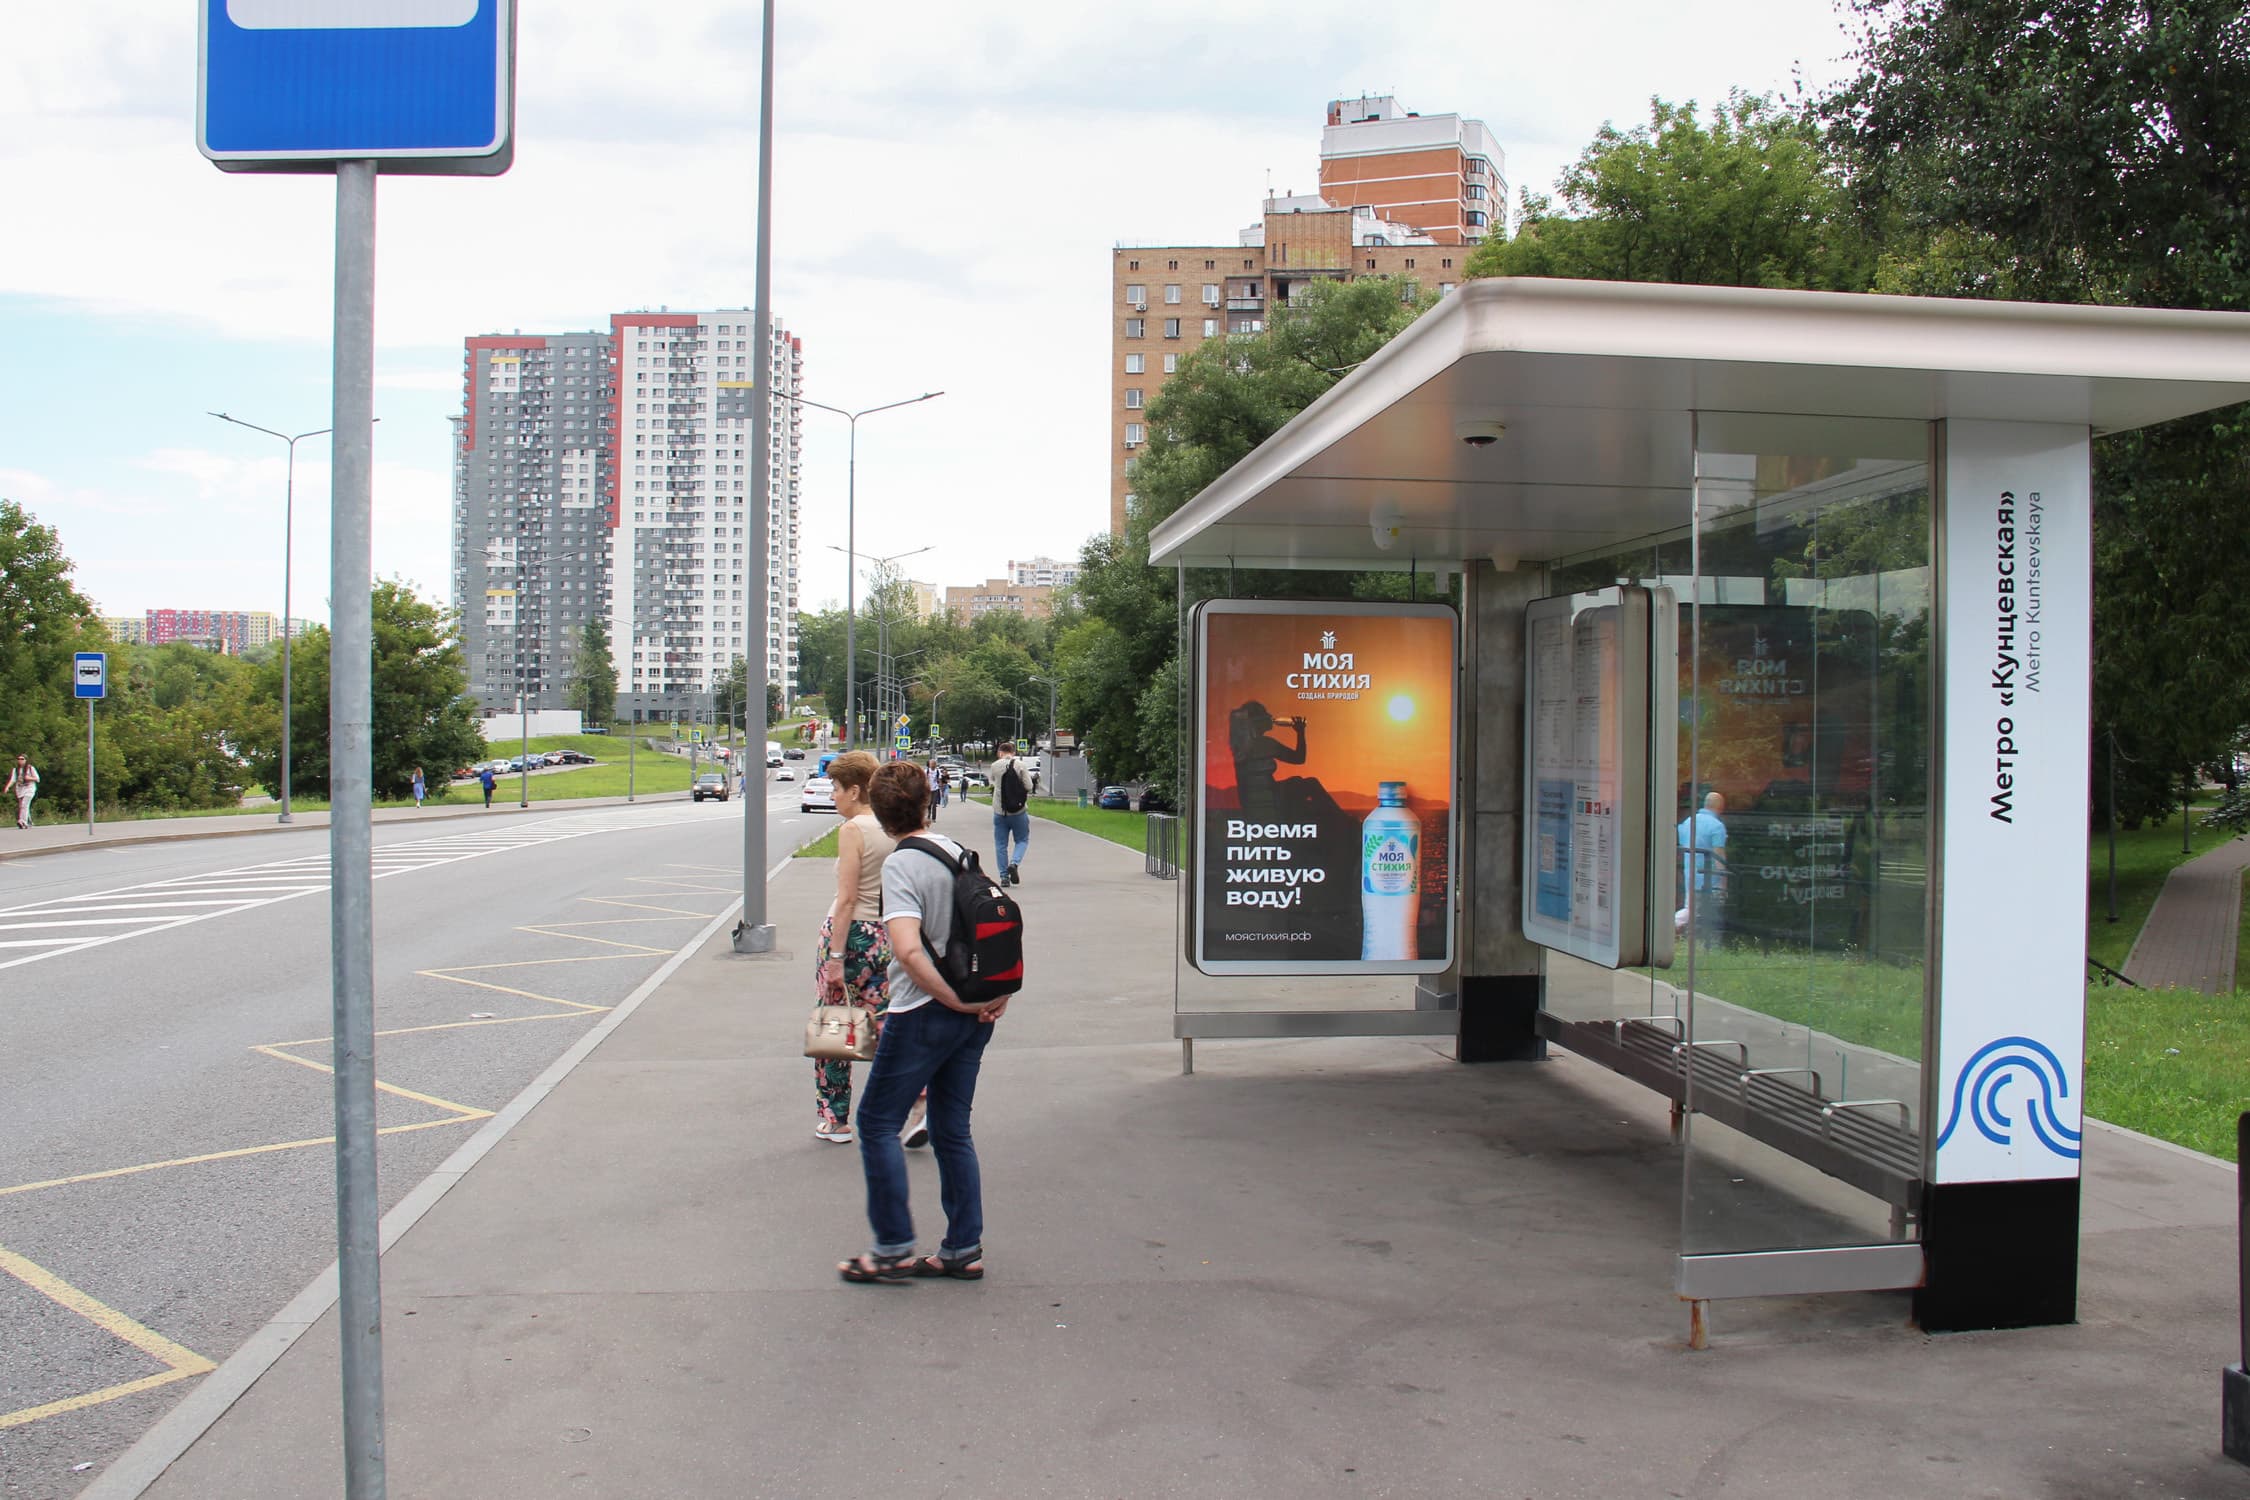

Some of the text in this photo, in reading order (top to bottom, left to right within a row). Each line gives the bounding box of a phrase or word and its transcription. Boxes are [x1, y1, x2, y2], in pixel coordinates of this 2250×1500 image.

[2024, 491, 2044, 693] Metro Kuntsevskaya
[1303, 653, 1354, 670] МОЯ
[1990, 490, 2020, 825] Метро «Кунцевская»
[1286, 673, 1371, 689] СТИХИЯ
[1227, 820, 1318, 841] Время
[1227, 847, 1292, 860] пить
[1379, 853, 1404, 861] МОЯ
[1371, 863, 1411, 871] СТИХИЯ
[1226, 868, 1326, 886] живую
[1226, 887, 1301, 909] воду!
